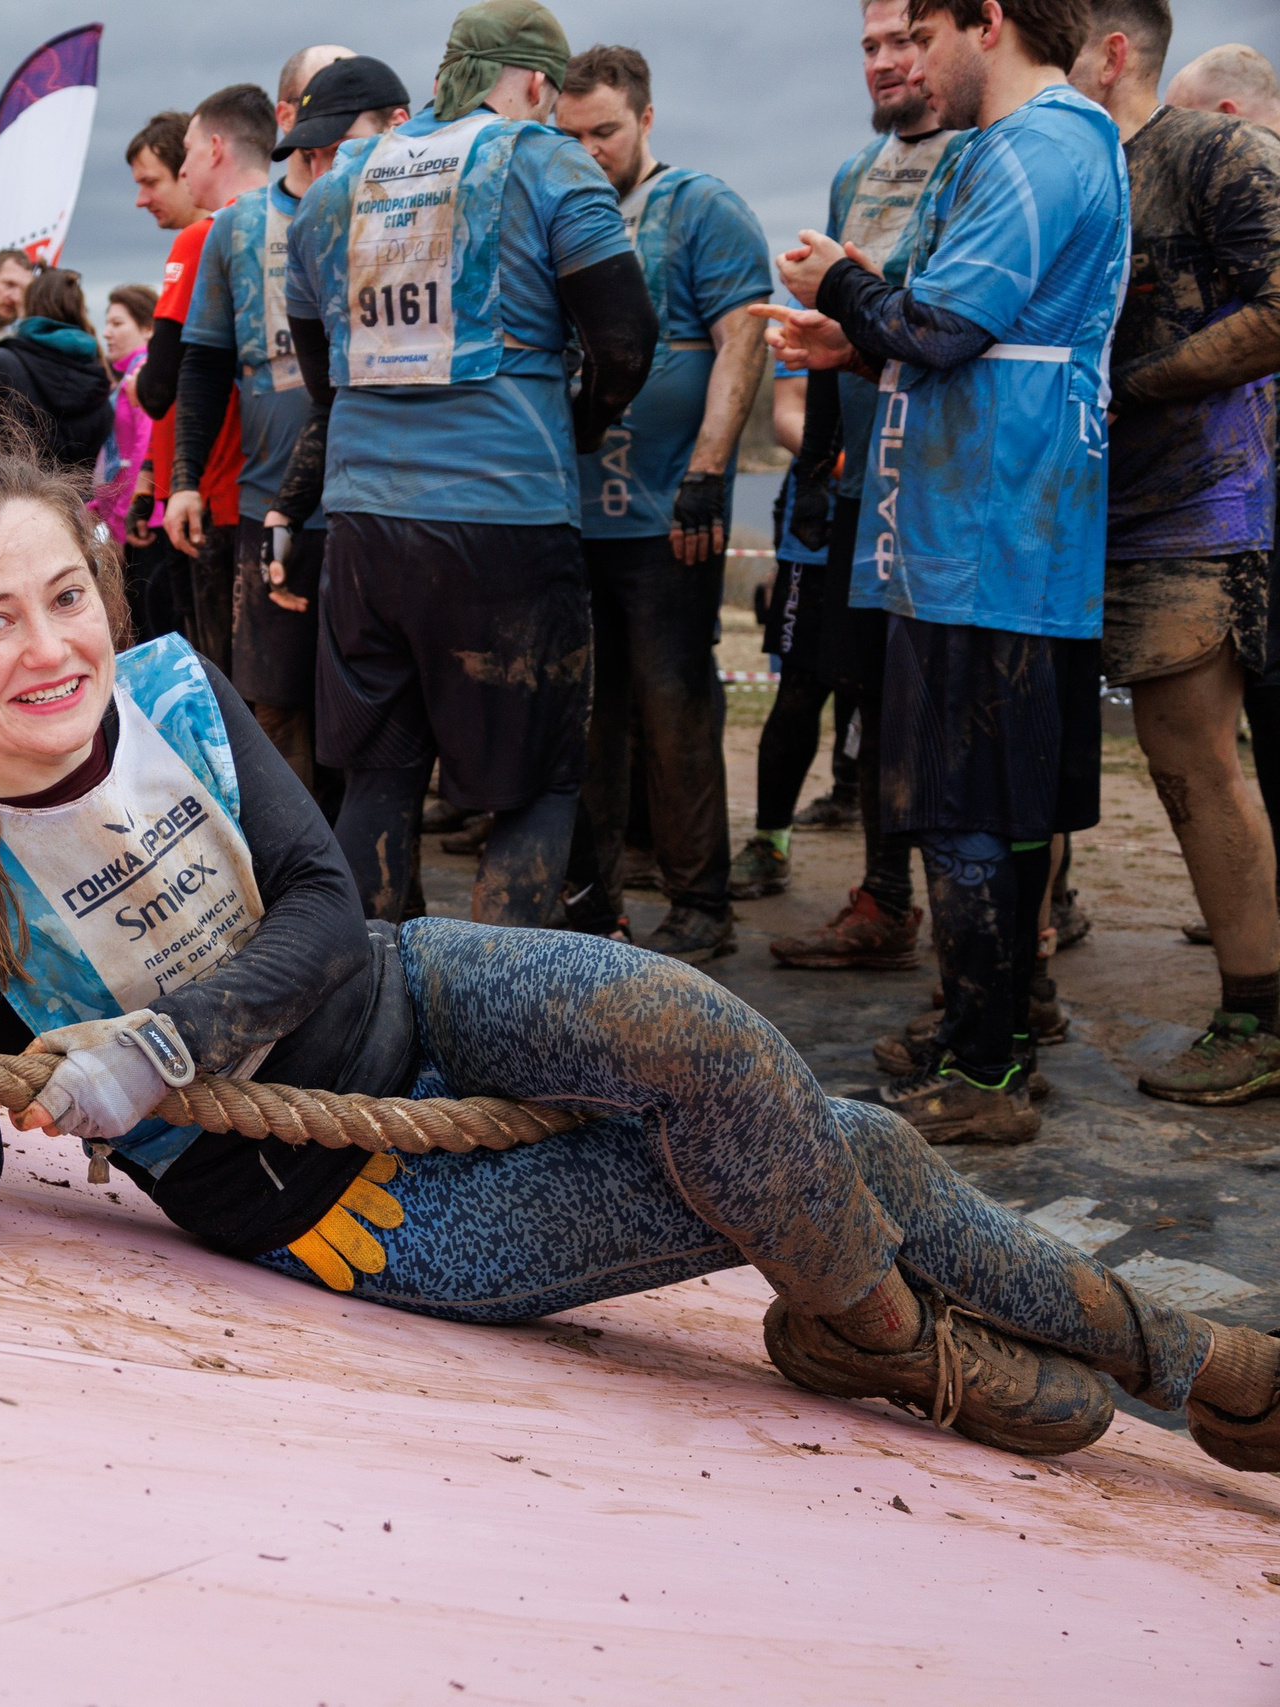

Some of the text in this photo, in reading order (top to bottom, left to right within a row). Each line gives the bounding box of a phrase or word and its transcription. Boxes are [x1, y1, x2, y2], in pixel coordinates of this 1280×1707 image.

[365, 157, 460, 180] ГОНКА ГЕРОЕВ
[356, 187, 452, 215] КОРПОРАТИВНЫЙ
[384, 211, 417, 229] СТАРТ
[358, 281, 438, 327] 9161
[275, 329, 291, 357] 9
[378, 354, 429, 364] ГАЗПРОМБАНК
[874, 358, 909, 580] ФАЛЬ
[62, 795, 202, 912] ГОНКА ГРОЕВ
[155, 961, 185, 986] FINE
[188, 905, 246, 963] DEVEPMENT
[148, 1030, 176, 1061] DEMIX
